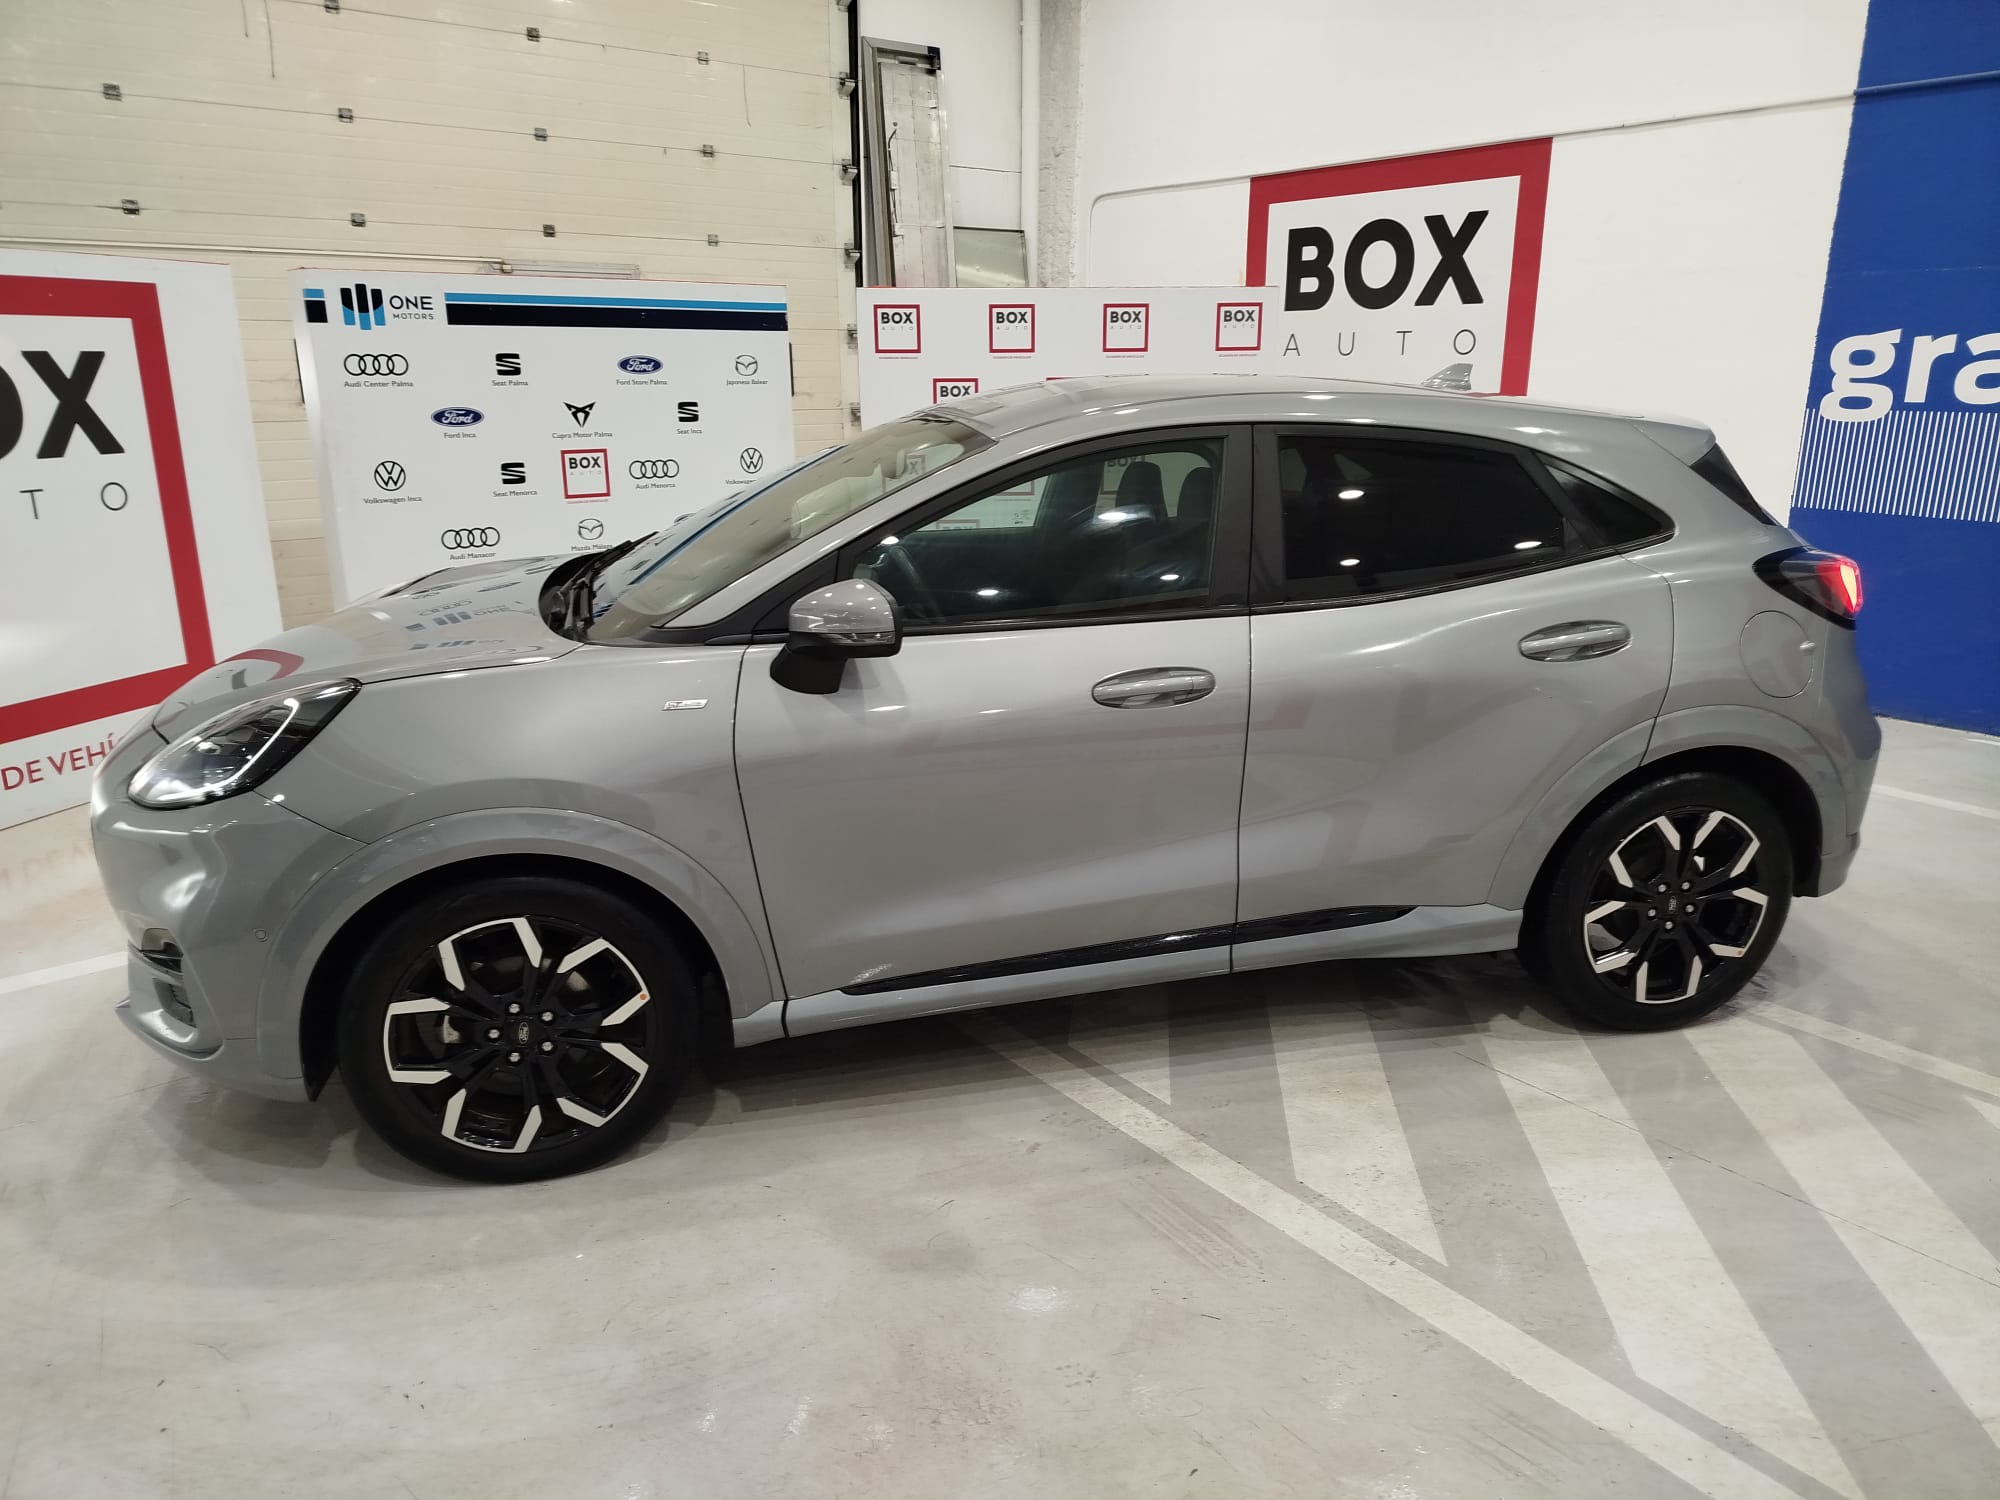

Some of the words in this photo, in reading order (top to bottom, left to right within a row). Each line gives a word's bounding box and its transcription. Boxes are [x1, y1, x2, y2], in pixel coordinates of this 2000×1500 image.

[1284, 210, 1489, 311] BOX
[390, 295, 434, 310] ONE
[881, 312, 914, 324] BOX
[996, 312, 1028, 324] BOX
[1110, 311, 1142, 323] BOX
[1223, 310, 1255, 322] BOX
[1283, 329, 1477, 357] AUTO
[391, 380, 414, 388] Palma
[649, 378, 668, 386] Palma
[940, 385, 971, 398] BOX
[552, 432, 572, 440] Cupra
[573, 431, 593, 439] Motor
[594, 430, 613, 438] Palma
[569, 456, 601, 469] BOX
[492, 490, 508, 498] Seat
[508, 488, 538, 497] Menorca
[363, 495, 406, 505] Volkswagen
[407, 494, 423, 502] Inca
[449, 553, 466, 561] Audi
[467, 551, 496, 559] Manacor
[1, 760, 44, 790] DE
